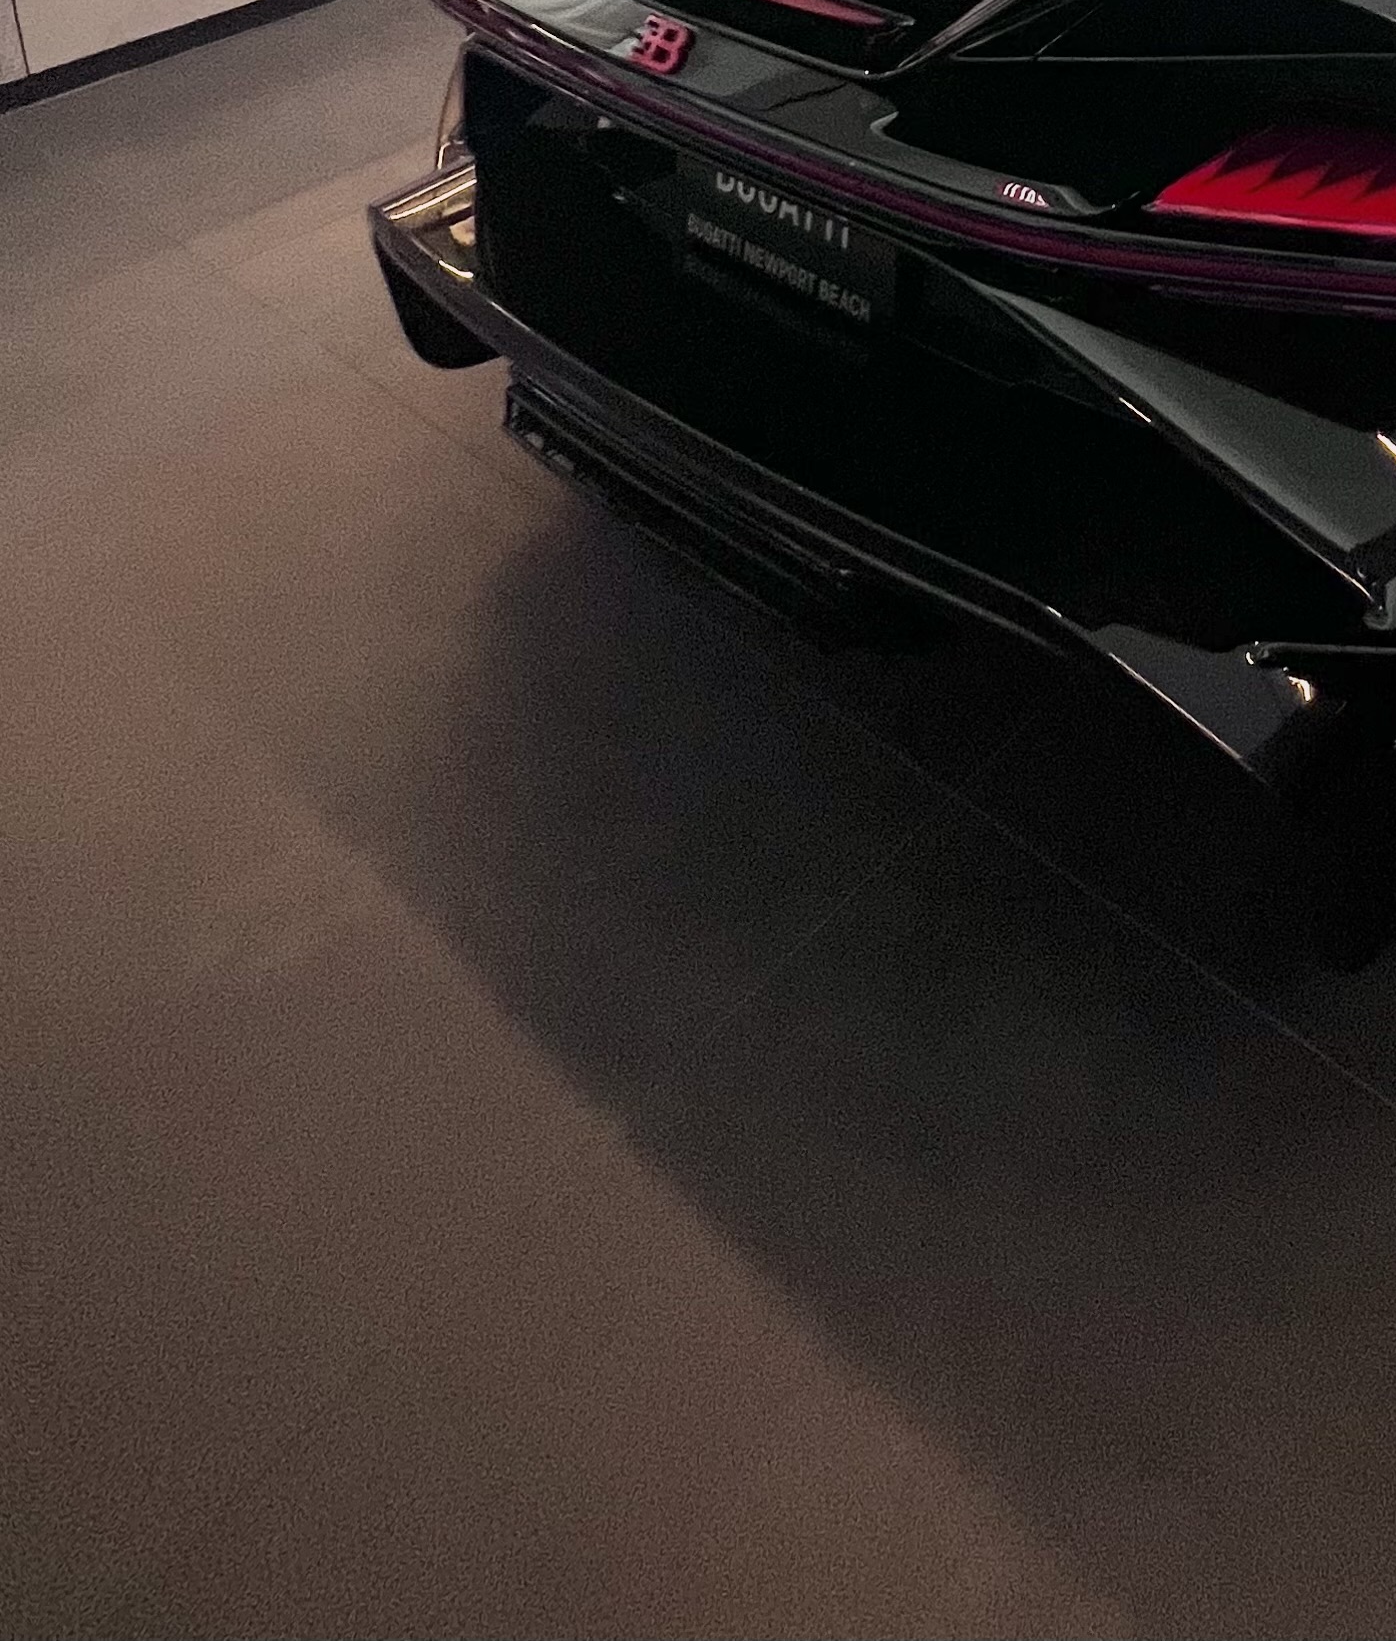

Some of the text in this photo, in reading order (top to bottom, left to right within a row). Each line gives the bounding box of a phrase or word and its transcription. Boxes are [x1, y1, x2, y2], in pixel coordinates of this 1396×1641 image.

[687, 213, 872, 323] BUGATTI NEWPORT BEACH
